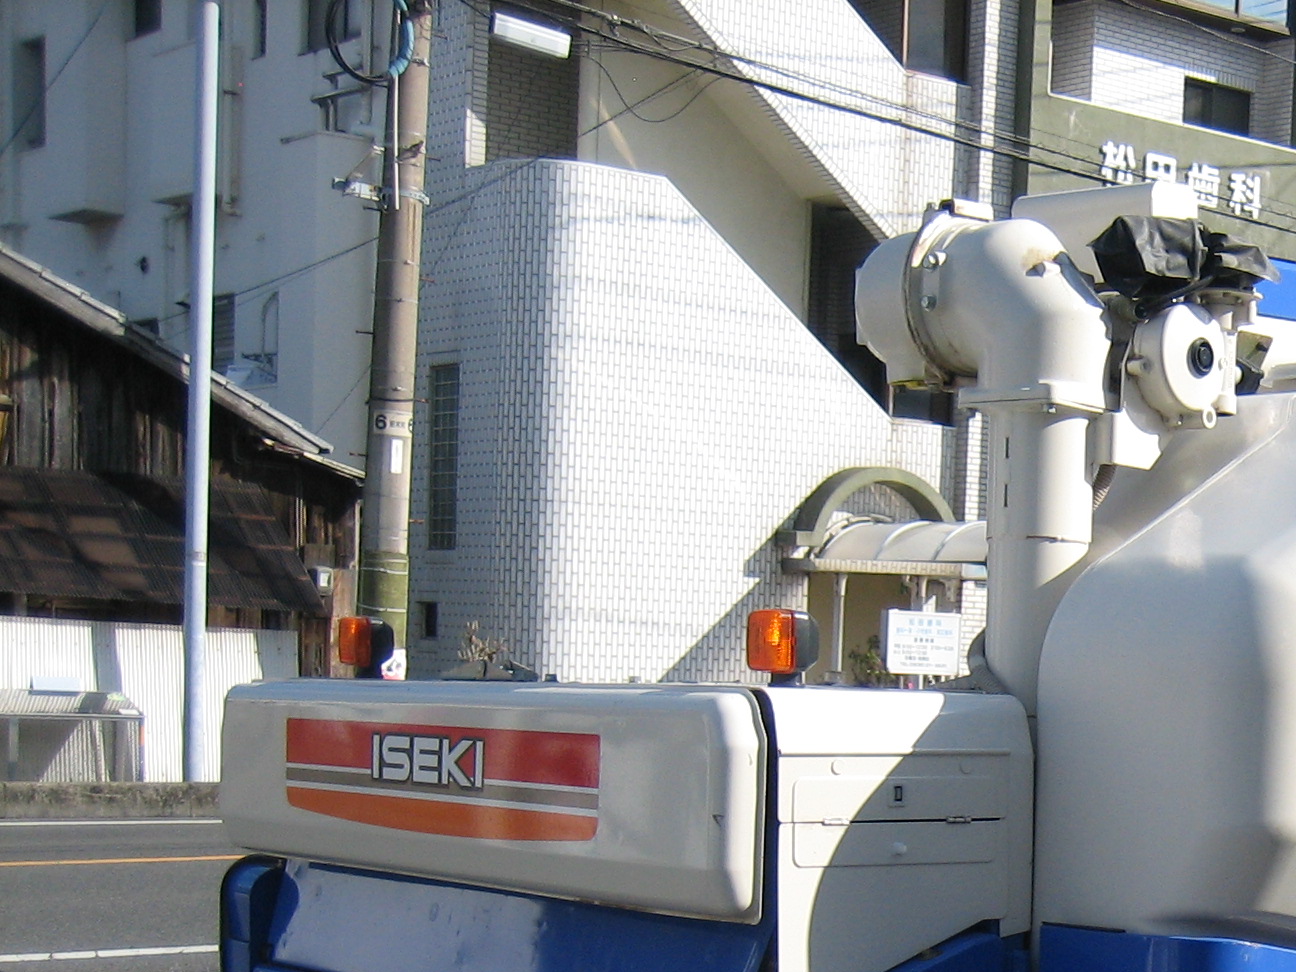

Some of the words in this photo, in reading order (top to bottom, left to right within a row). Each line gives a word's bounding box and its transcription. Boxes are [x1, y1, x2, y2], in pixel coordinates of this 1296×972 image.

[1101, 141, 1262, 219] 松田歯科
[375, 414, 387, 430] 6
[371, 731, 486, 792] ISEKI
